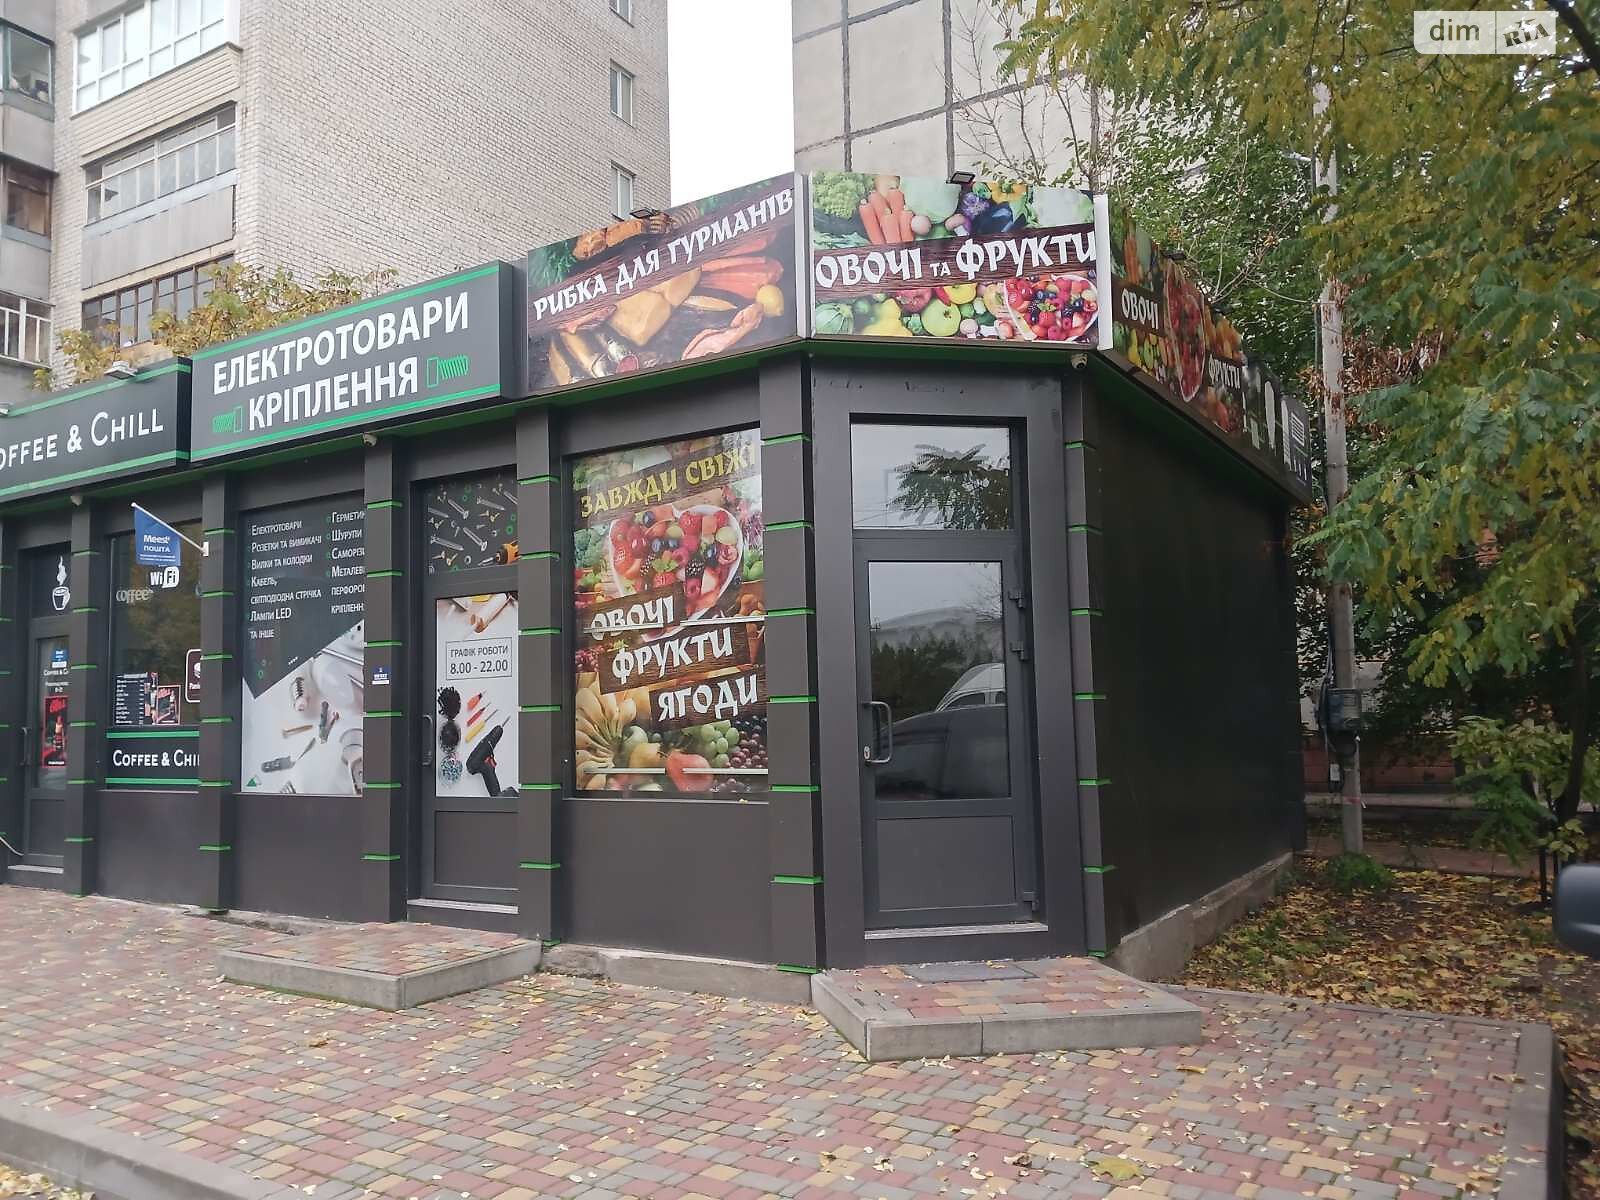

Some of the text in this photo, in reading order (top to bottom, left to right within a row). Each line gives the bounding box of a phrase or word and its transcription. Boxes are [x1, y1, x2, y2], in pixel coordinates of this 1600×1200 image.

[534, 188, 794, 321] РИБКА ДЛЯ ГУРМАНІВ
[814, 231, 1097, 289] ОВОЧІ ТА ФРУКТИ
[1121, 288, 1160, 329] ОВОЧІ
[213, 291, 469, 396] ЕЛЕКТРОТОВАРИ
[248, 355, 419, 431] КРІПЛЕННЯ
[67, 424, 83, 453] &
[91, 408, 164, 447] CHILL
[581, 469, 678, 518] ЗАВЖДИ
[251, 521, 302, 536] ЕЛЕКТРОТОВАРИ
[251, 541, 279, 553] РОЗЕТКИ
[331, 529, 363, 542] ШУРУПИ
[275, 608, 292, 620] LED
[591, 595, 675, 642] ОВОЧІ
[450, 644, 508, 659] ГРАФІК РОБОТИ
[450, 661, 472, 675] 8.00
[480, 658, 509, 674] 22.00
[611, 627, 733, 685] ФРУКТИ
[657, 674, 758, 722] ЯГОДИ
[112, 749, 159, 767] COFFEE
[161, 752, 171, 767] &
